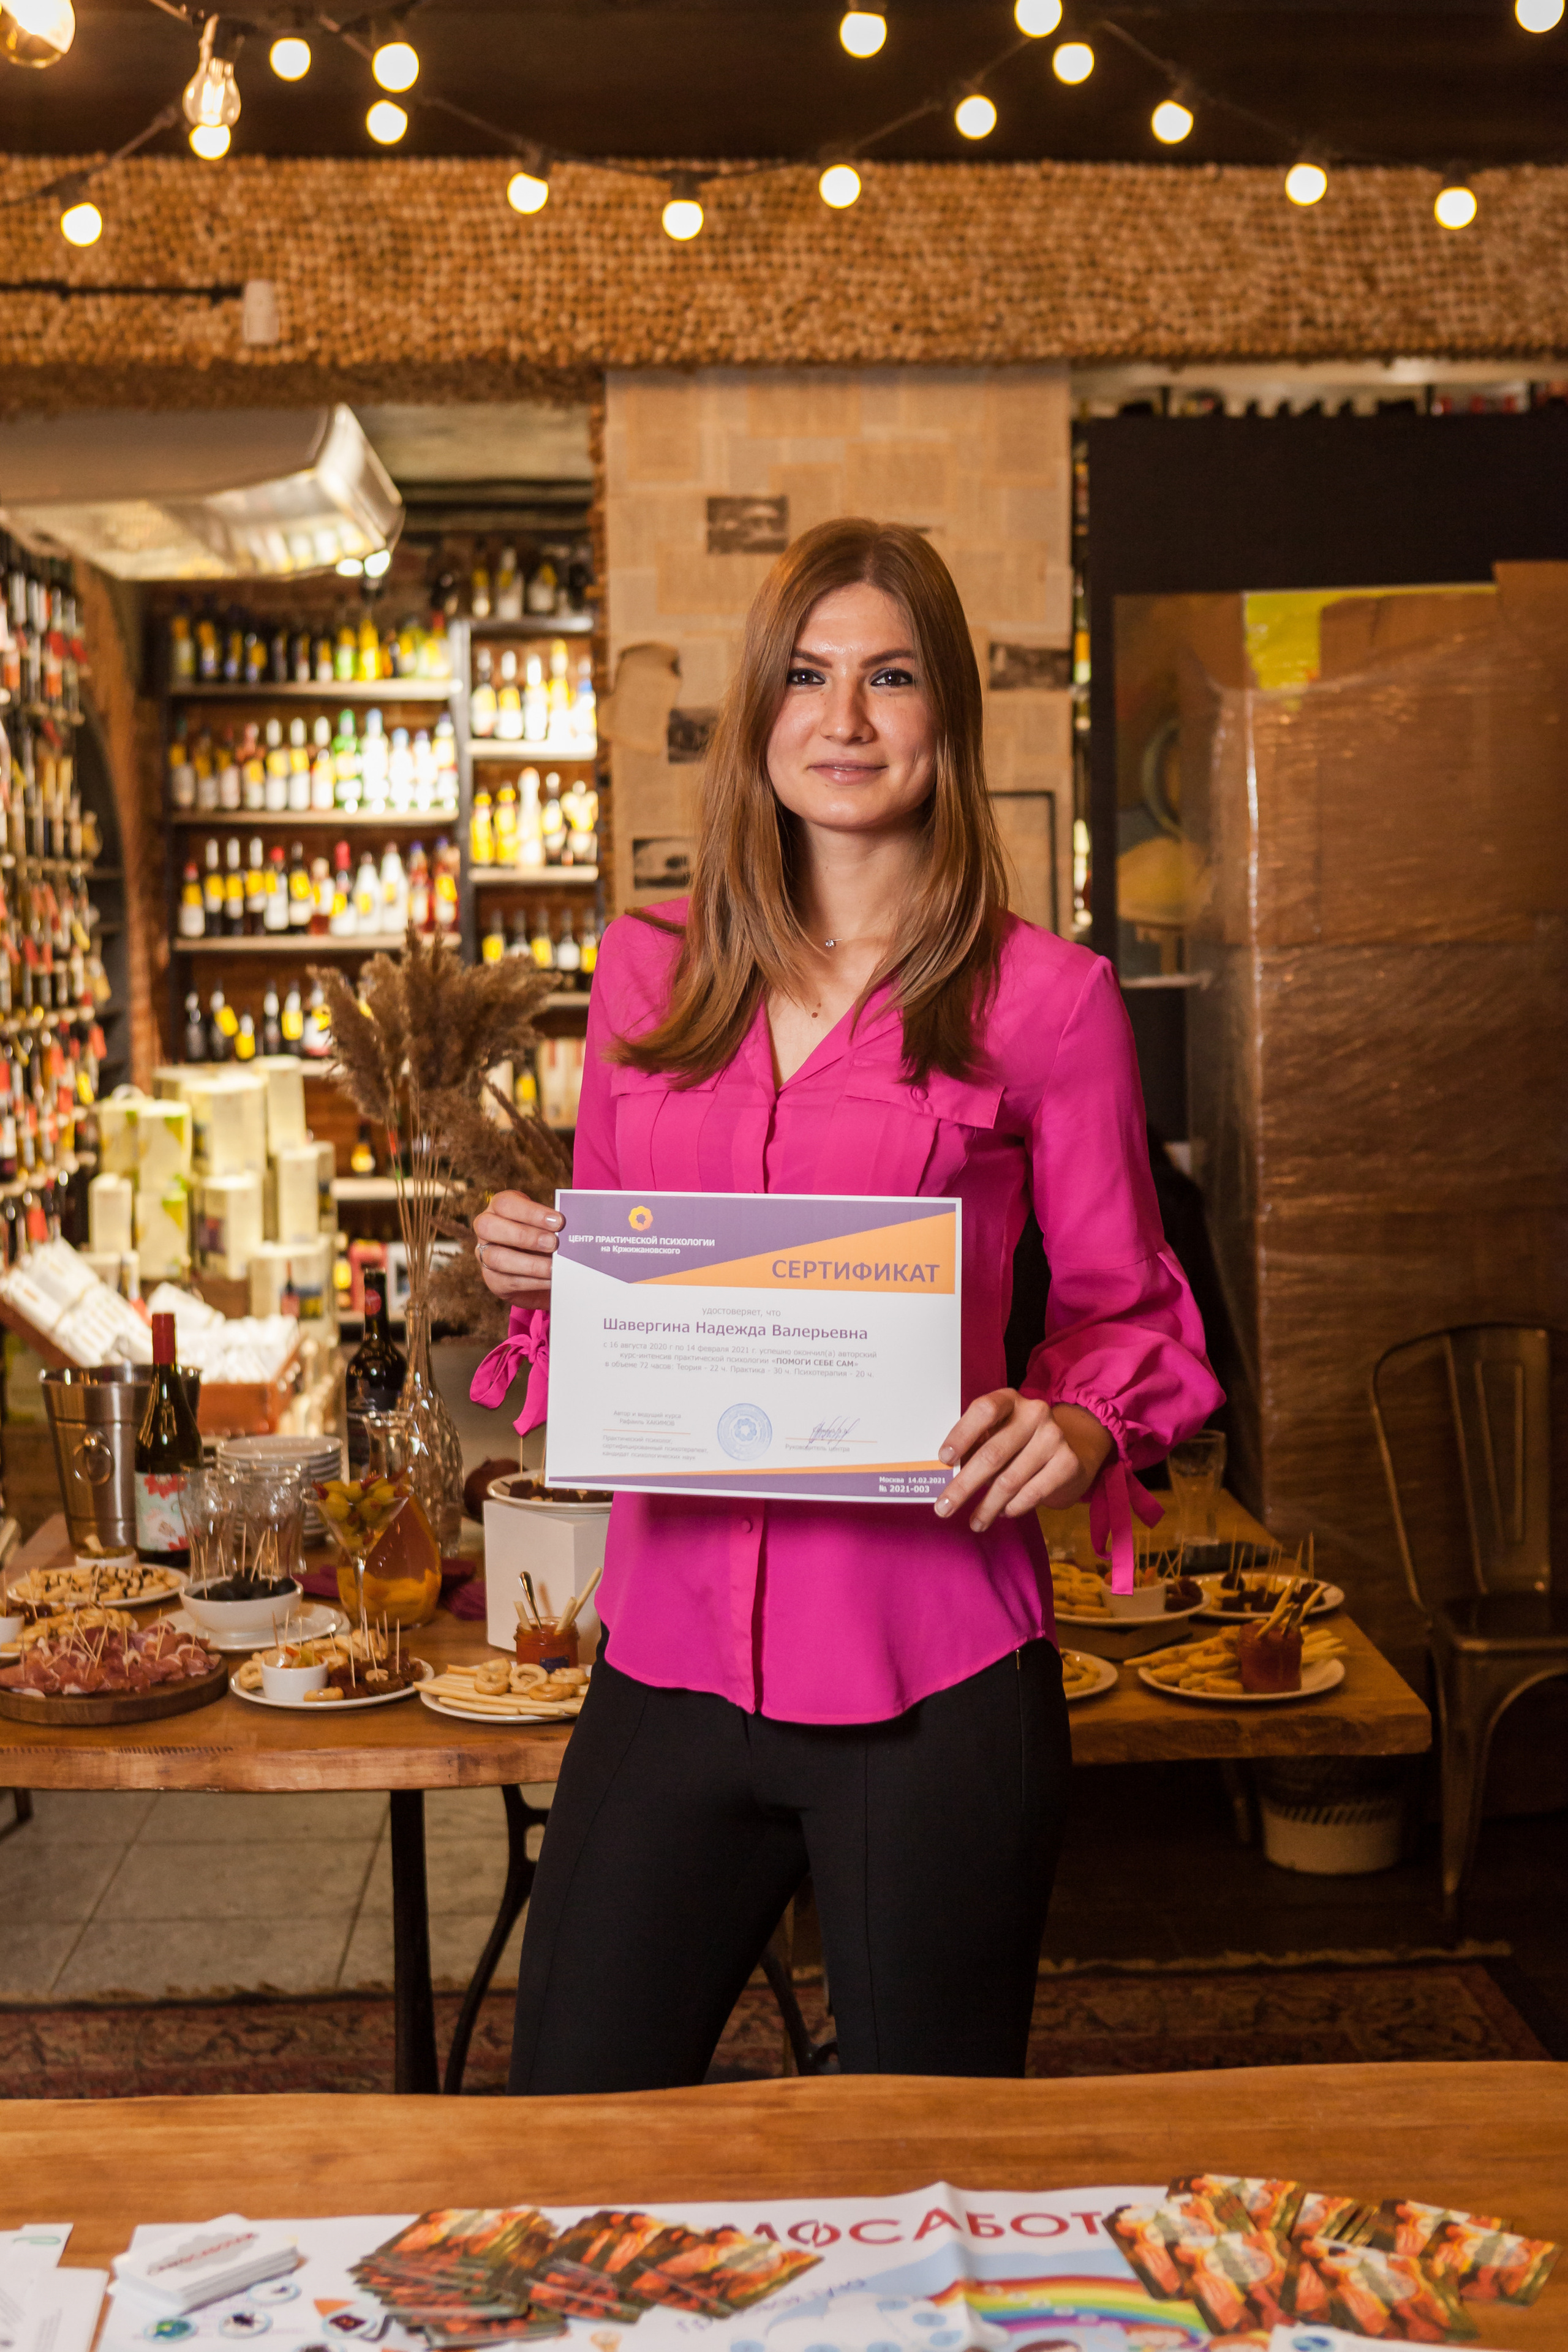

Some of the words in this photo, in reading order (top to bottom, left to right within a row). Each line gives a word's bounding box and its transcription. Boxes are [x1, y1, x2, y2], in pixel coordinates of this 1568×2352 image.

[568, 1235, 594, 1243] ЦЕНТР
[595, 1235, 658, 1245] ПРАКТИЧЕСКОЙ
[660, 1238, 715, 1246] ПСИХОЛОГИИ
[612, 1245, 680, 1254] Кржижановского
[772, 1259, 940, 1283] СЕРТИФИКАТ
[702, 1307, 763, 1317] удостоверяет,
[603, 1317, 690, 1334] Шавергина
[696, 1322, 766, 1336] Надежда
[772, 1324, 868, 1340] Валерьевна
[677, 1363, 702, 1371] Теория
[731, 1365, 765, 1374] Практика
[794, 1368, 847, 1378] Психотерапия
[889, 1485, 930, 1493] 2021-003
